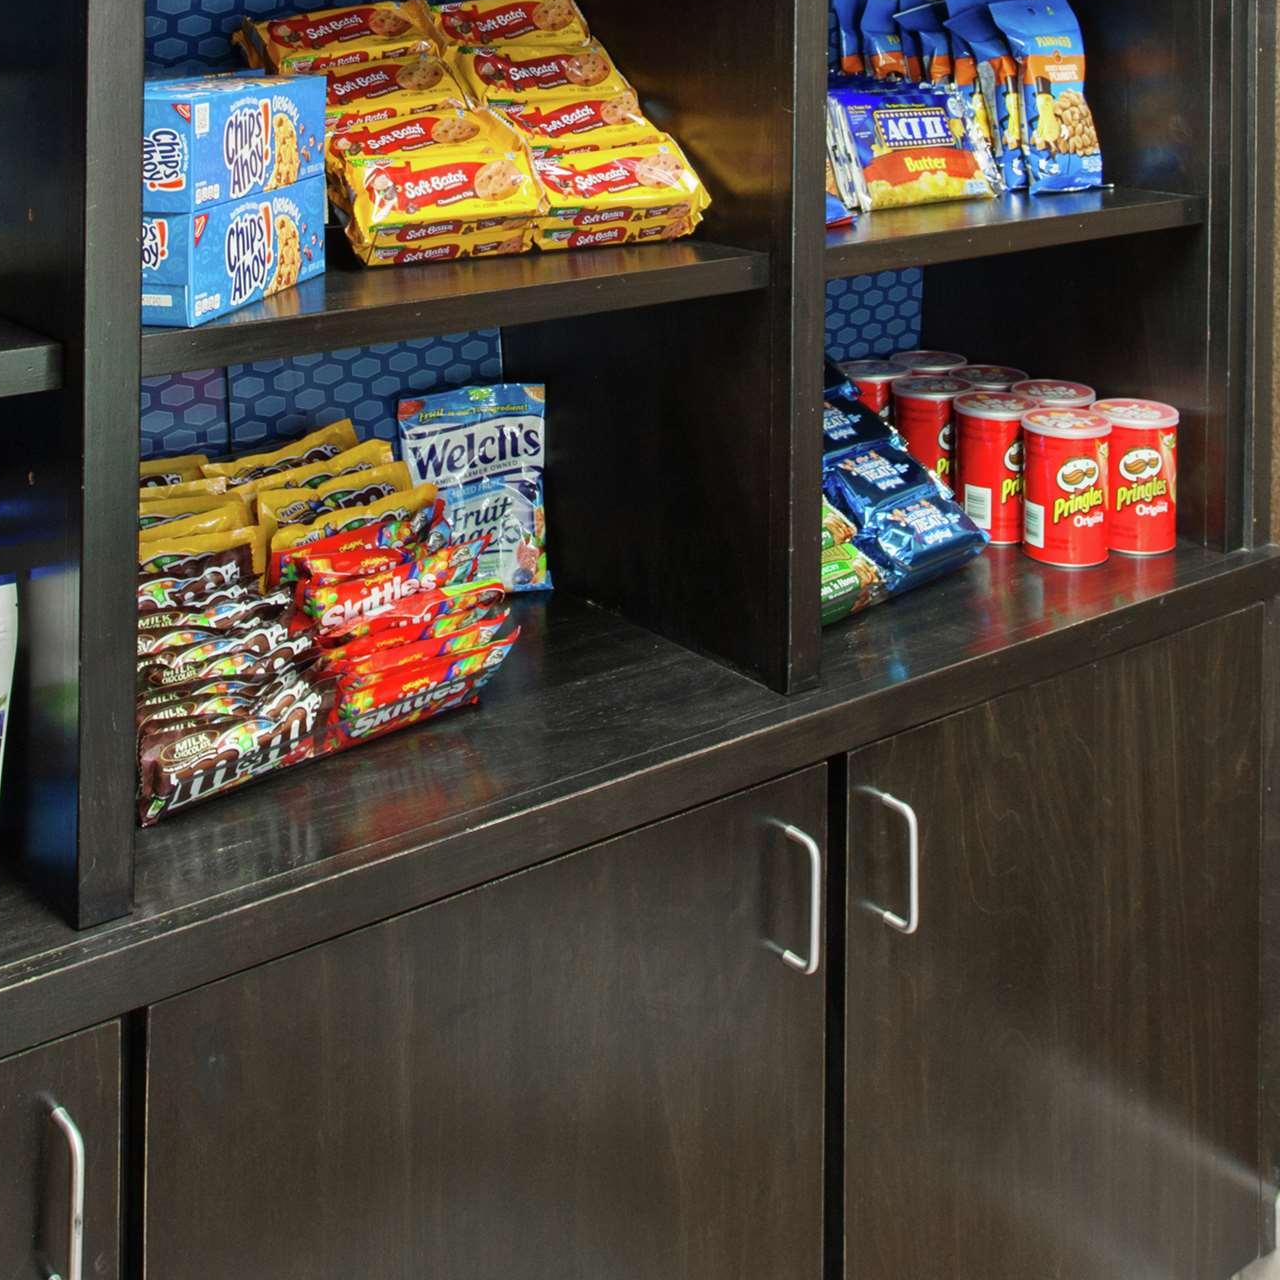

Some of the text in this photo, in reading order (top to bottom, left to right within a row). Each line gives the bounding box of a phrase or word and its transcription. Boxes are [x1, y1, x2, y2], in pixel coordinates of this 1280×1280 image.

[306, 14, 363, 40] Soft Batch
[497, 8, 527, 25] Batch
[333, 70, 390, 96] Soft Batch
[272, 95, 300, 125] ORIGINAL
[562, 106, 596, 124] Batch
[226, 109, 263, 164] Chips
[367, 123, 426, 150] Soft Batch
[888, 117, 946, 140] ACT II
[152, 129, 180, 180] Chips
[904, 156, 946, 172] Butter
[404, 169, 469, 200] Soft Batch
[273, 197, 301, 227] ORIGINAL
[228, 214, 264, 273] Chips
[576, 233, 598, 247] Soft
[403, 249, 424, 263] Soft
[409, 423, 541, 480] Welch's
[1053, 487, 1103, 524] Pringles
[1116, 477, 1167, 512] Pringles
[280, 501, 306, 519] PEANUT
[451, 496, 512, 529] Fruit
[322, 573, 439, 626] Skittles
[174, 741, 215, 760] CHOCOLATE
[176, 733, 211, 750] MILK
